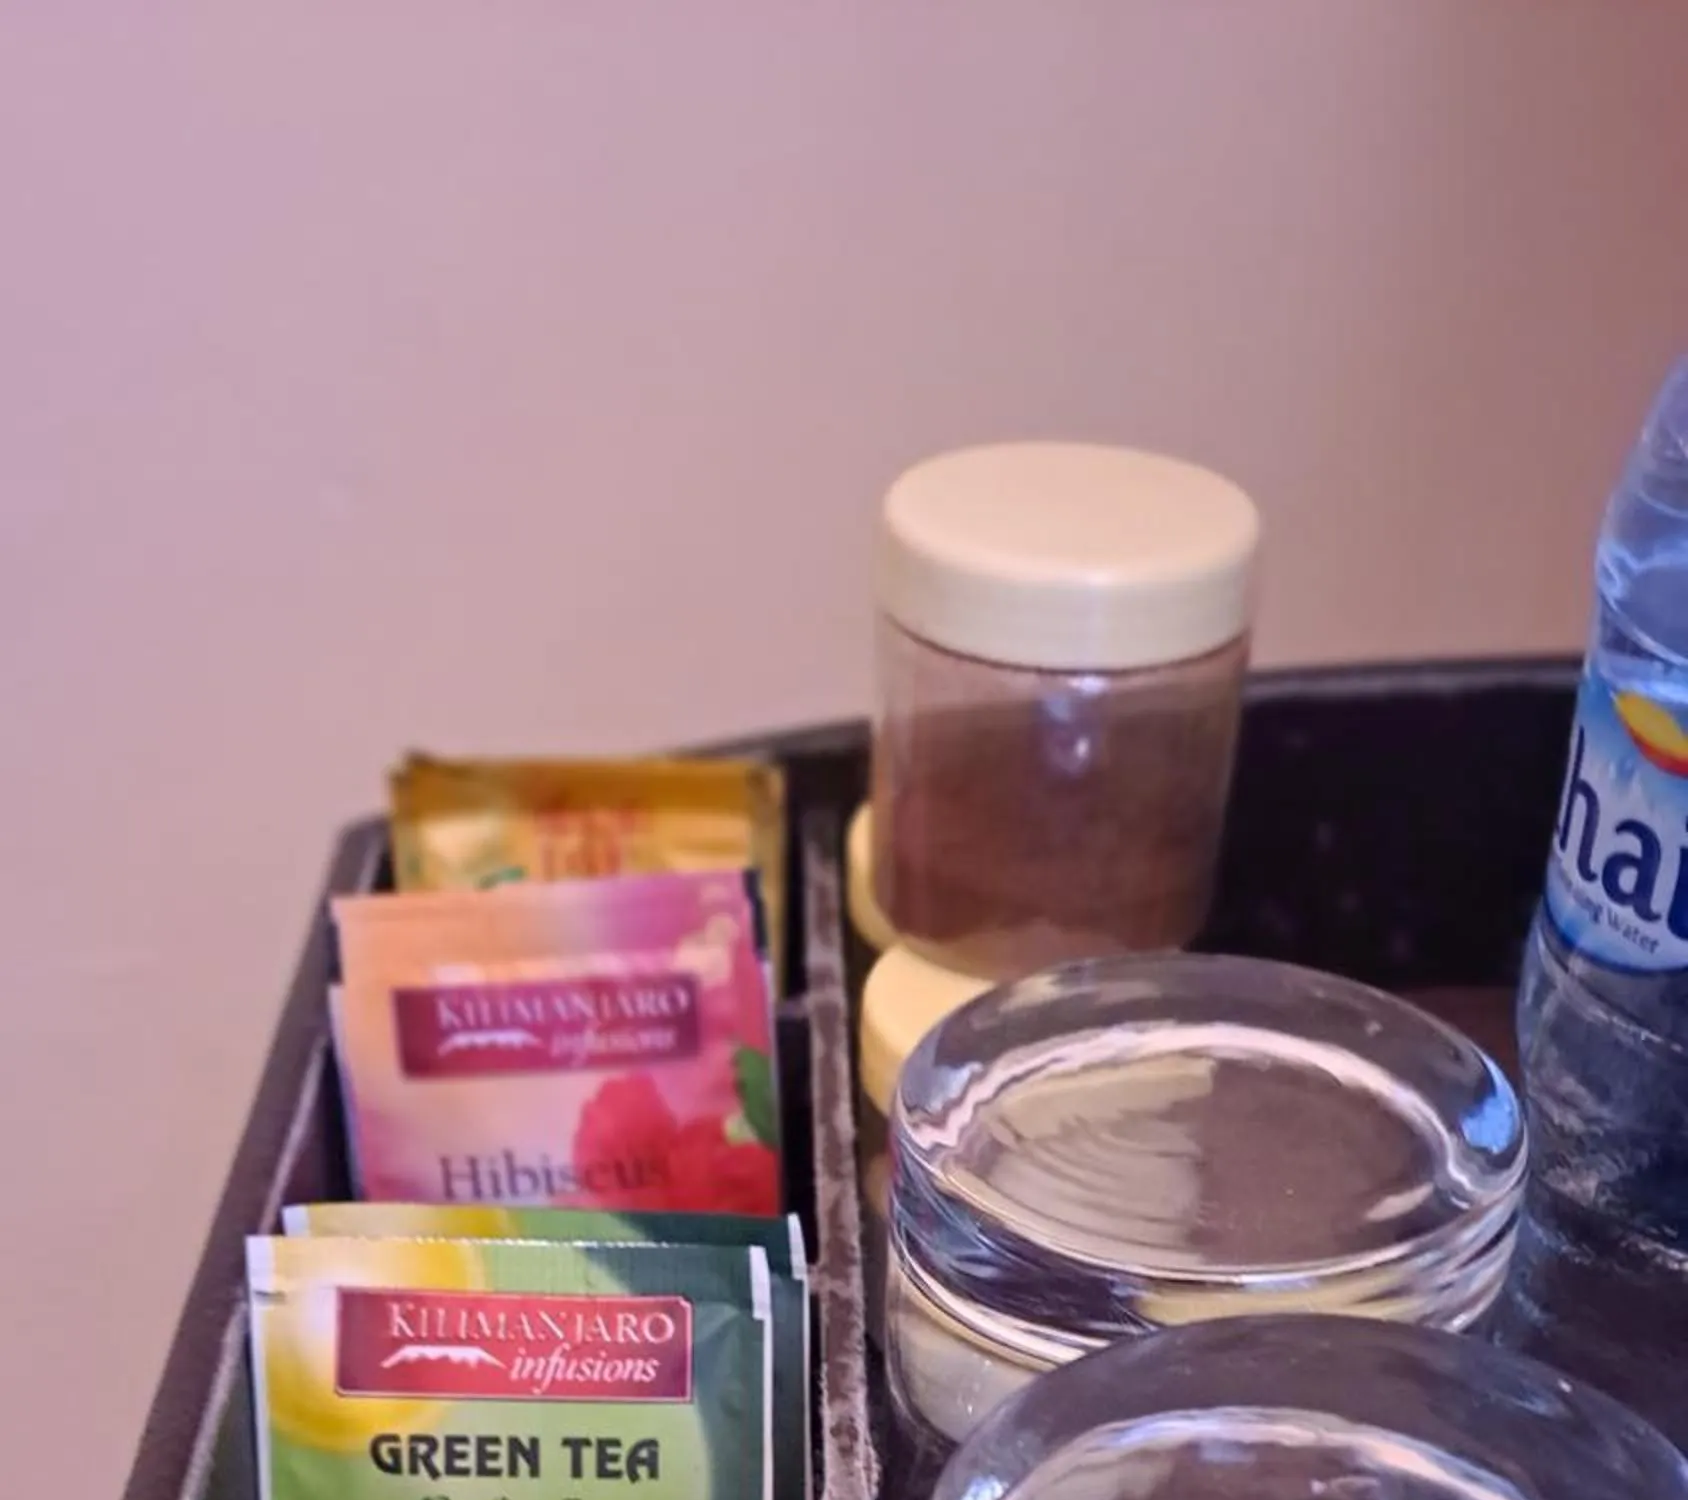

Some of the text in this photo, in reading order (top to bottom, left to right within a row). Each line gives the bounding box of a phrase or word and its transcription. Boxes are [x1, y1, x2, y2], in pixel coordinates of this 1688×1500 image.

[436, 987, 692, 1030] KILIMANJARO
[438, 1148, 668, 1200] Hibiscus
[386, 1302, 677, 1346] KILIMANJARO
[508, 1342, 661, 1396] infusions
[369, 1432, 661, 1484] GREEN TEA
